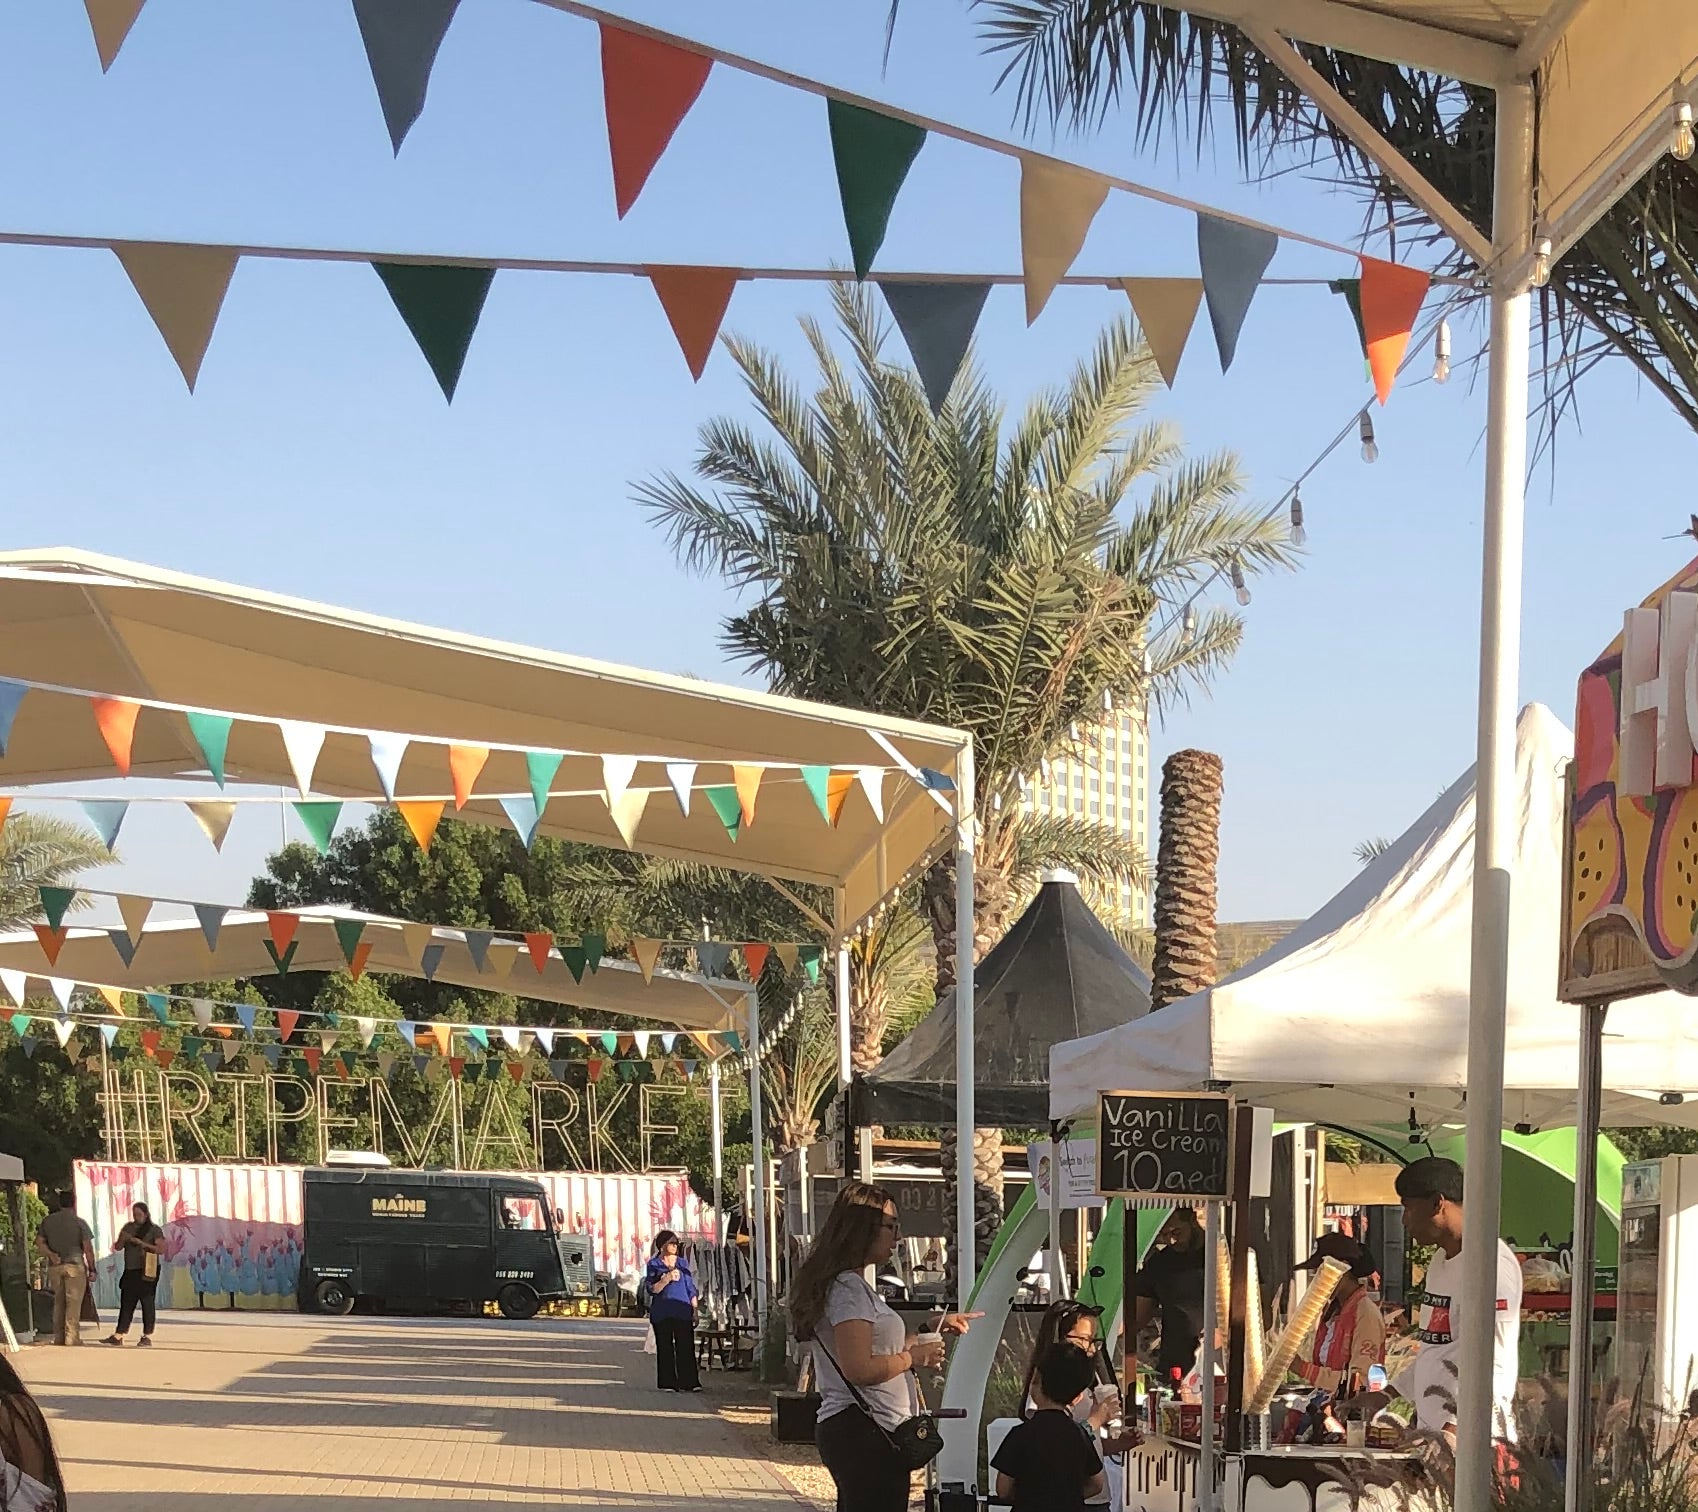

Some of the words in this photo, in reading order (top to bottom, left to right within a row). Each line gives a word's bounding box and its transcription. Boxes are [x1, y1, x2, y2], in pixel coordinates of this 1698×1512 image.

[1618, 591, 1698, 797] H
[1110, 1129, 1145, 1147] Ice
[1152, 1129, 1222, 1154] Cream
[1112, 1149, 1162, 1193] 10
[1164, 1157, 1223, 1193] aed
